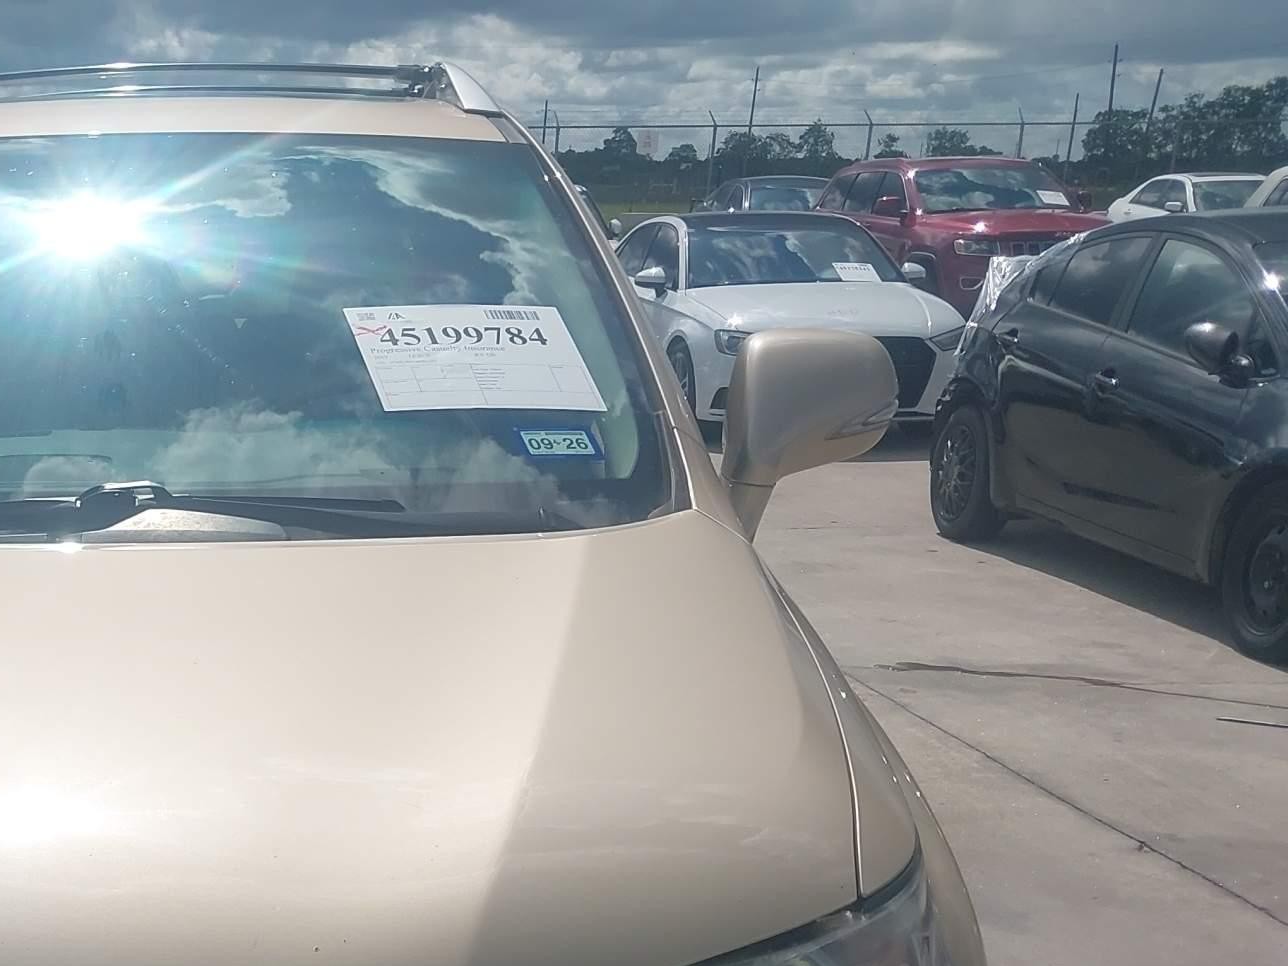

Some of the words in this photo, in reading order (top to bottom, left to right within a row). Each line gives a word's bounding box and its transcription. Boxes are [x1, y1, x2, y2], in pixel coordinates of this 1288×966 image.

[379, 325, 548, 347] 45199784
[527, 437, 554, 450] 09
[562, 437, 589, 450] 26
